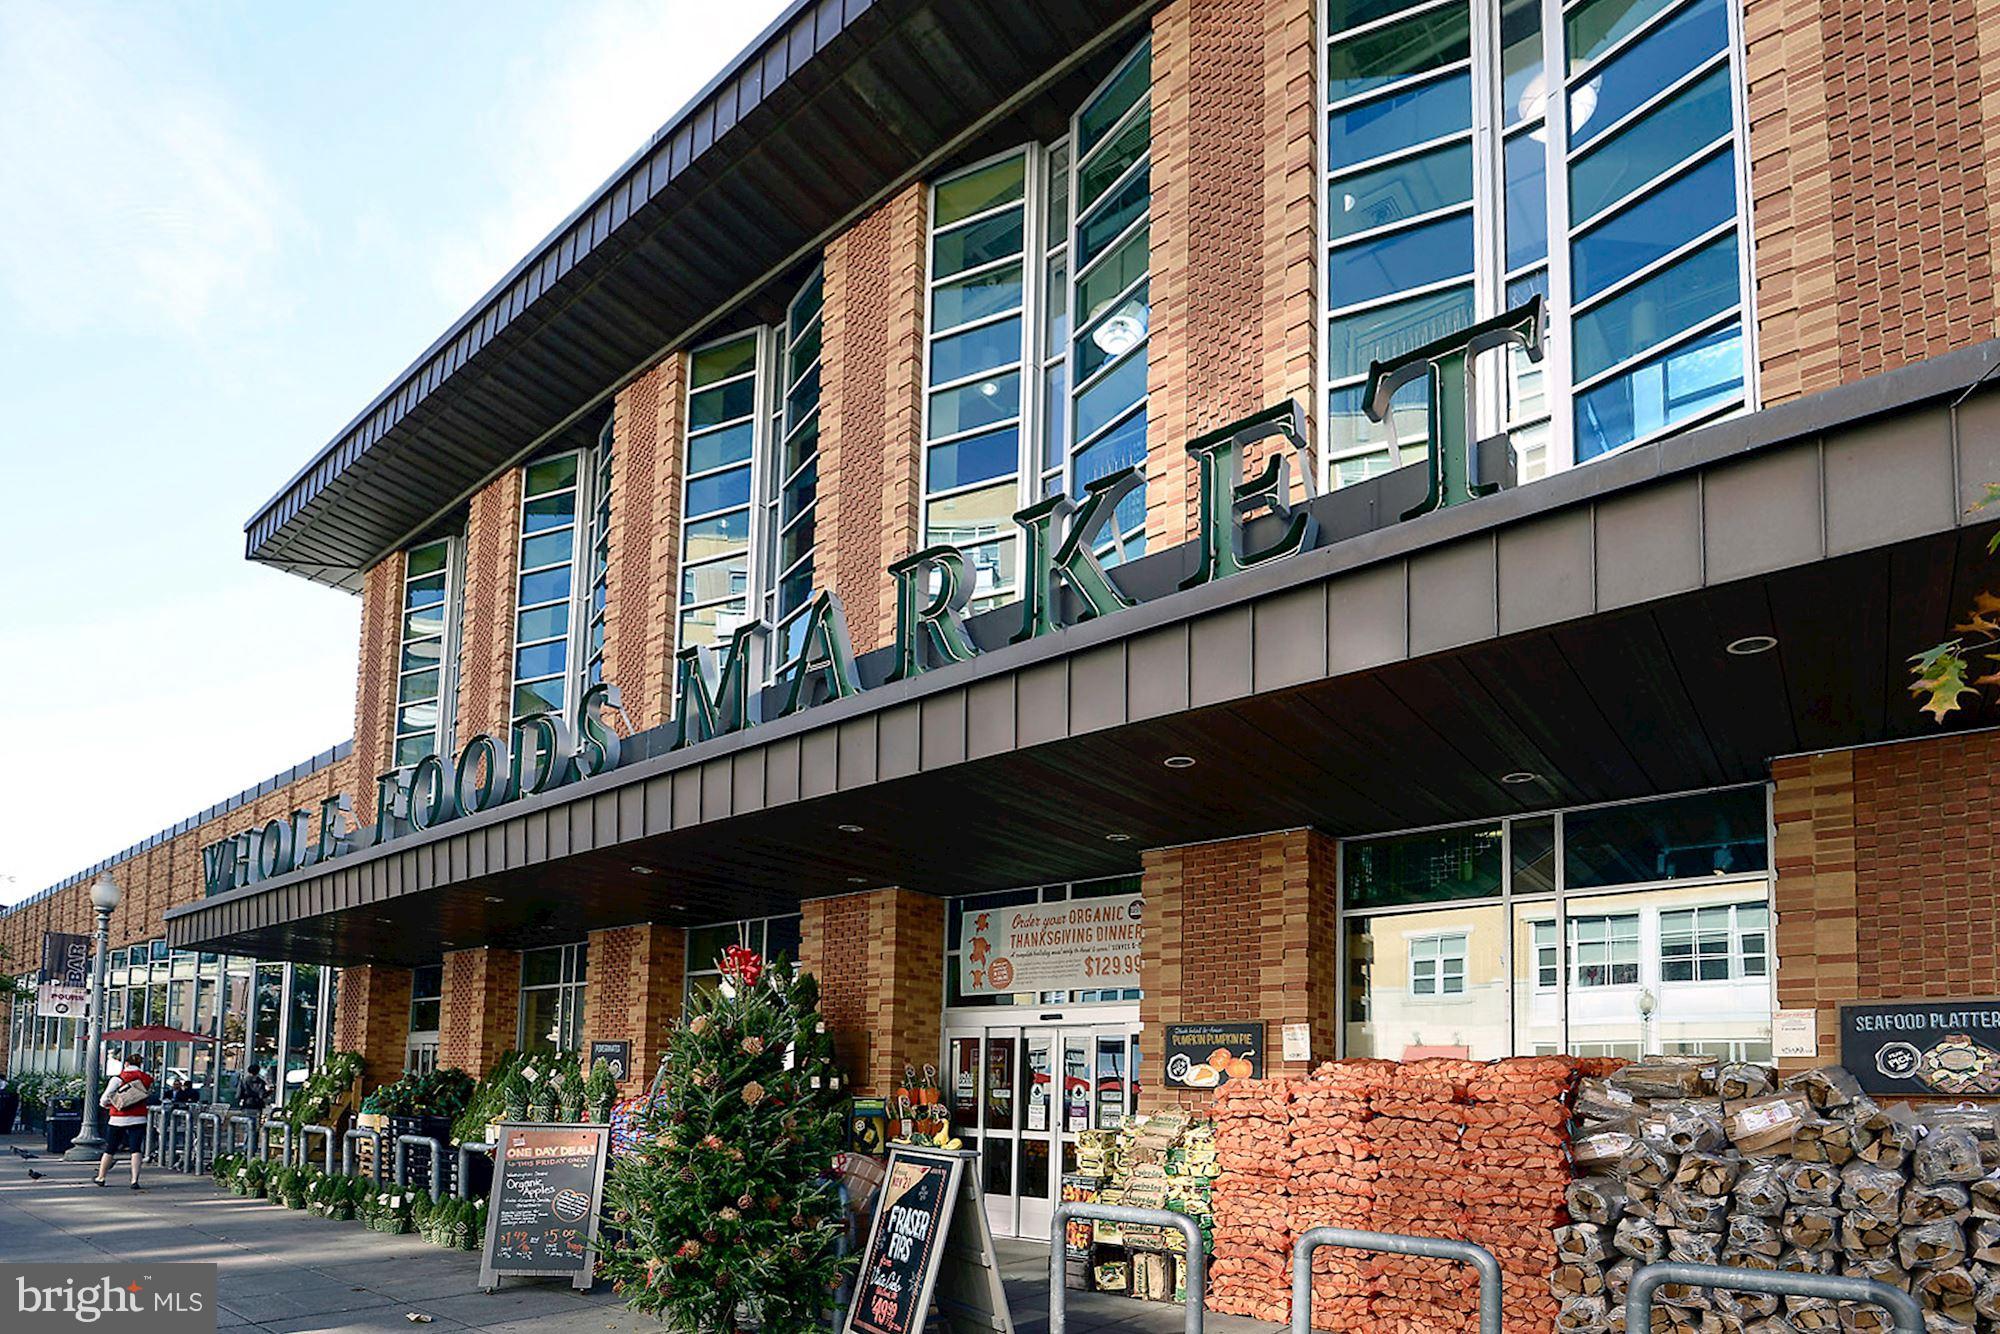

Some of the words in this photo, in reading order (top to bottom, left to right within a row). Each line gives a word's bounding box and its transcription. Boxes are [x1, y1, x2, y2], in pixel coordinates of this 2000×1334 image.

[200, 794, 354, 898] WHOLE
[370, 681, 622, 846] FOODS
[674, 293, 1547, 752] MARKET
[1011, 912, 1041, 930] Order
[1042, 914, 1066, 933] your
[1069, 905, 1124, 925] ORGANIC
[1010, 927, 1093, 949] THANKSGIVING
[1084, 953, 1142, 978] $129.99
[1855, 1013, 1926, 1032] SEAFOOD
[1240, 1033, 1253, 1045] PIE
[507, 1147, 532, 1158] ONE
[534, 1146, 560, 1157] DAY
[517, 1160, 534, 1168] THIS
[535, 1157, 567, 1167] FRIDAY
[567, 1156, 590, 1164] ONLY
[506, 1178, 543, 1192] Organic
[522, 1184, 556, 1199] Apples
[888, 1205, 931, 1242] FRASER
[888, 1232, 914, 1264] FIRS
